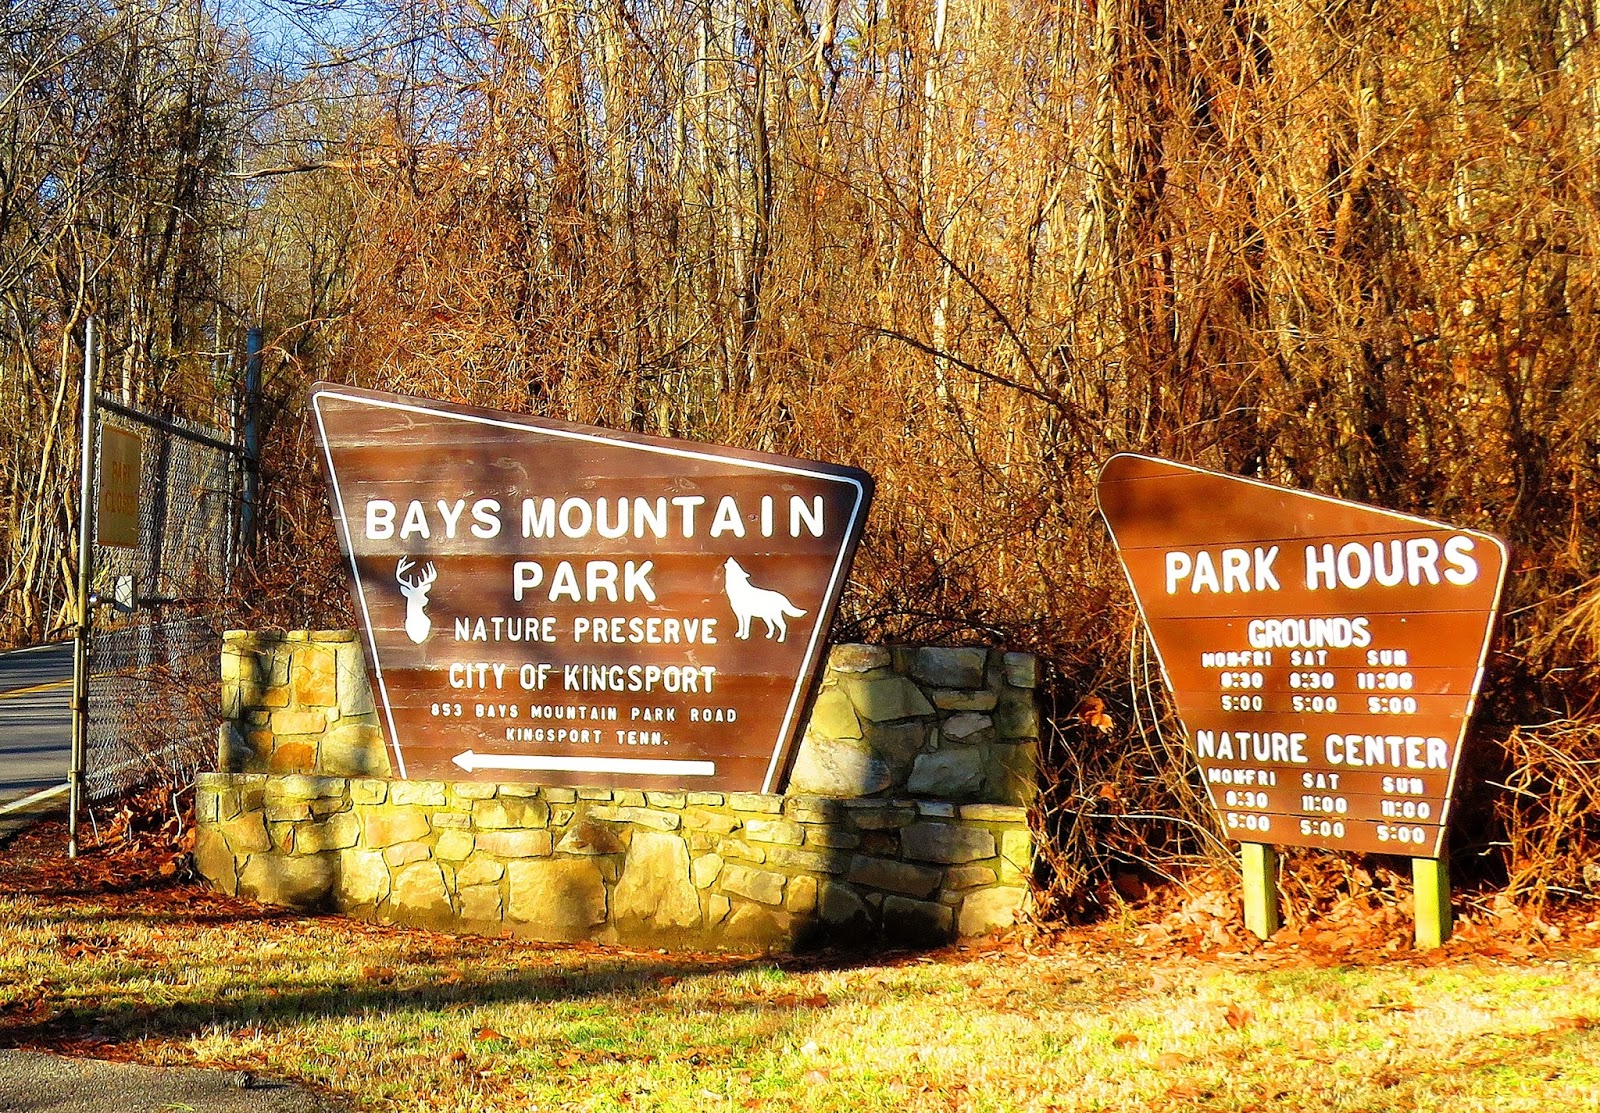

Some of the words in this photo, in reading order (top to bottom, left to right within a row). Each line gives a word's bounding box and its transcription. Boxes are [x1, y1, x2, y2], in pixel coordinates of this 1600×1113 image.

[365, 498, 503, 541] BAYS
[521, 495, 825, 540] MOUNTAIN
[1164, 545, 1281, 595] PARK
[1304, 536, 1479, 591] HOURS
[513, 559, 658, 603] PARK
[454, 617, 557, 644] NATURE
[573, 618, 719, 645] PRESERVE
[1247, 618, 1371, 648] GROUNDS
[1290, 650, 1328, 667] SAT
[1366, 650, 1408, 666] SUN
[448, 663, 506, 691] CITY
[519, 663, 549, 691] OF
[564, 663, 717, 693] KINGSPORT
[1219, 671, 1264, 689] 8:30
[1289, 671, 1335, 689] 8:30
[430, 702, 464, 718] 853
[475, 703, 519, 719] BAYS
[530, 703, 618, 722] MOUNTAIN
[631, 706, 676, 722] PARK
[690, 707, 738, 723] ROAD
[1221, 694, 1263, 712] 5:00
[1292, 696, 1338, 713] 5:00
[1367, 697, 1417, 715] 5:00
[505, 727, 603, 744] KINGSPORT
[616, 729, 671, 746] TENN.
[1196, 730, 1309, 763] NATURE
[1325, 735, 1448, 770] CENTER
[1302, 773, 1340, 791] SAT
[1381, 776, 1424, 795] SUN
[1225, 790, 1268, 808] 8:30
[1227, 812, 1270, 832] 5:00
[1300, 819, 1346, 838] 5:00
[1376, 824, 1426, 845] 5:00
